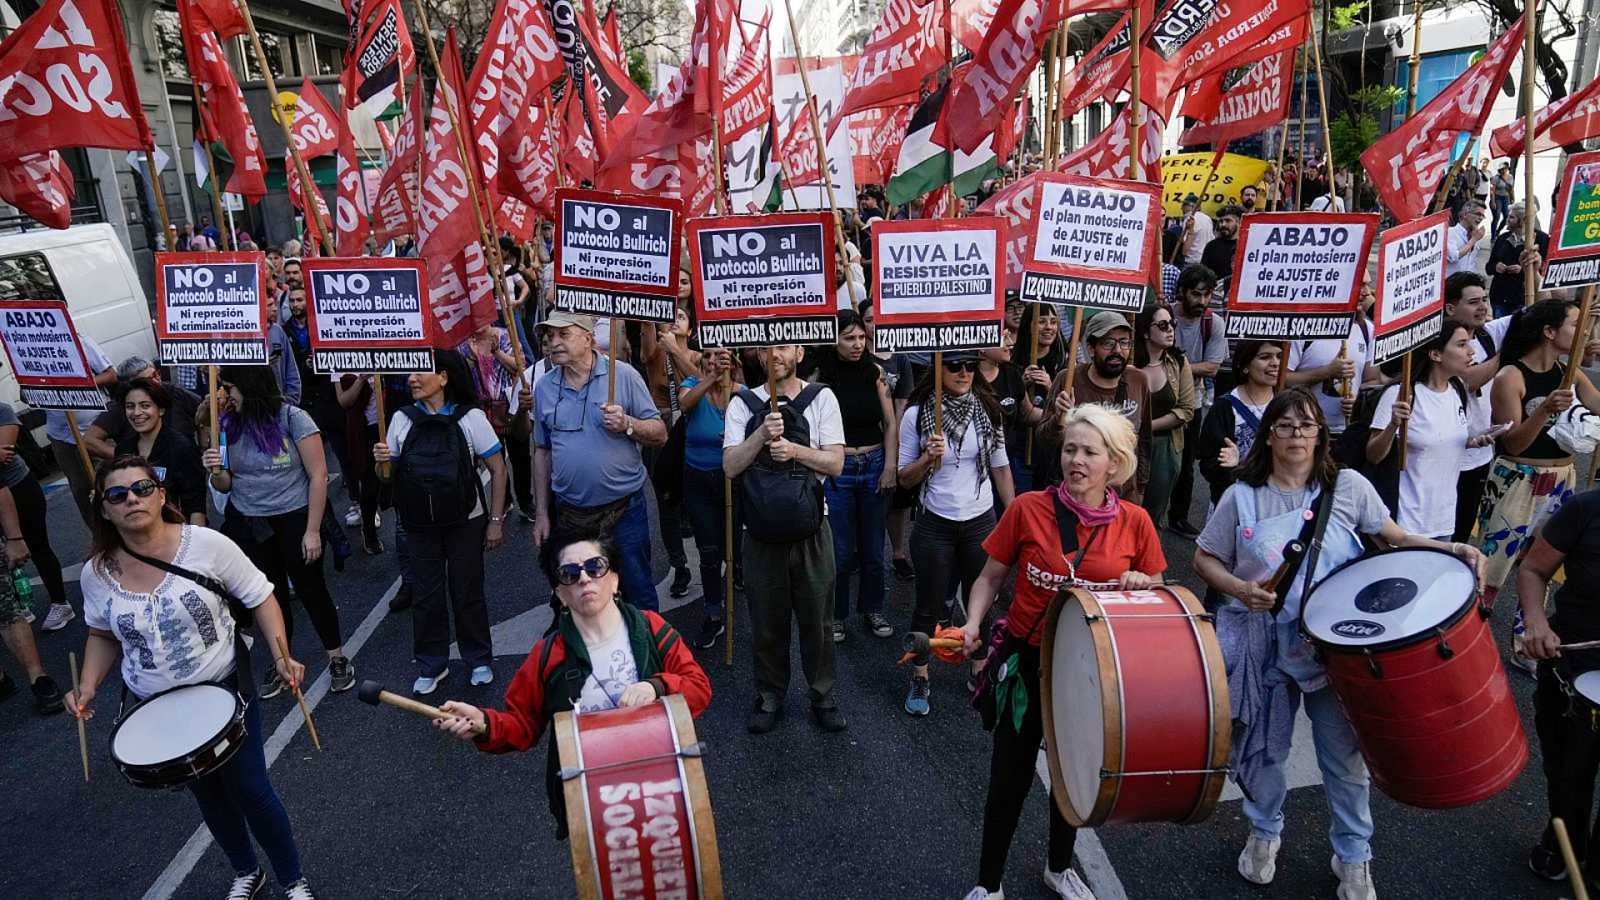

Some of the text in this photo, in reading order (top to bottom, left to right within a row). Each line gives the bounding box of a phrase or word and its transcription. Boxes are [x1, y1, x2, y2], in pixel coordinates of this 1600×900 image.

[1059, 188, 1135, 212] ABAJO
[575, 206, 647, 230] NO al
[1043, 208, 1143, 230] el plan motosierra
[567, 231, 666, 253] protocolo Bullrich
[712, 232, 796, 257] NO al
[1054, 227, 1128, 247] de AJUSTE de
[1265, 228, 1348, 246] ABAJO
[1396, 229, 1438, 262] ABAJO
[579, 252, 651, 268] Ni represión
[889, 243, 982, 263] VIVA LA
[1051, 244, 1126, 263] MILEI y el FMI
[1248, 249, 1355, 265] el plan motosierra
[565, 264, 665, 283] Ni criminalización
[707, 252, 820, 280] protocolo Bullrich
[884, 263, 989, 279] RESISTENCIA
[1258, 268, 1339, 281] de AJUSTE de
[1386, 268, 1393, 282] el
[1395, 265, 1410, 280] plan
[1545, 259, 1598, 286] IZQUIERDA
[174, 268, 236, 288] NO al
[323, 274, 395, 294] NO al
[723, 279, 805, 294] Ni represión
[894, 283, 931, 296] PUEBLO
[934, 280, 986, 294] PALESTINO
[1394, 272, 1435, 298] de AJUSTE de
[170, 286, 255, 307] protocolo Bullrich
[708, 292, 823, 308] Ni criminalización
[1025, 276, 1140, 307] IZQUIERDA SOCIALISTA
[1256, 285, 1336, 301] MILEI y el FMI
[1392, 286, 1434, 315] MILEI y el FMI
[181, 308, 243, 319] Ni represión
[320, 293, 417, 314] protocolo Bullrich
[558, 290, 673, 319] IZQUIERDA SOCIALISTA
[6, 312, 56, 327] ABAJO
[170, 320, 257, 331] Ni criminalización
[334, 316, 405, 327] Ni represión
[1227, 316, 1350, 338] IZQUIERDA SOCIALISTA
[5, 330, 72, 344] el plan motosierra
[321, 328, 420, 338] Ni criminalización
[703, 321, 834, 347] IZQUIERDA SOCIALISTA
[877, 325, 999, 352] IZQUIERDA SOCIALISTA
[17, 346, 68, 358] de AJUSTE de
[163, 342, 264, 364] IZQUIERDA SOCIALISTA
[317, 352, 431, 372] IZQUIERDA SOCIALISTA
[22, 361, 74, 374] MILEI y el FMI
[599, 782, 645, 900] SOCIAL
